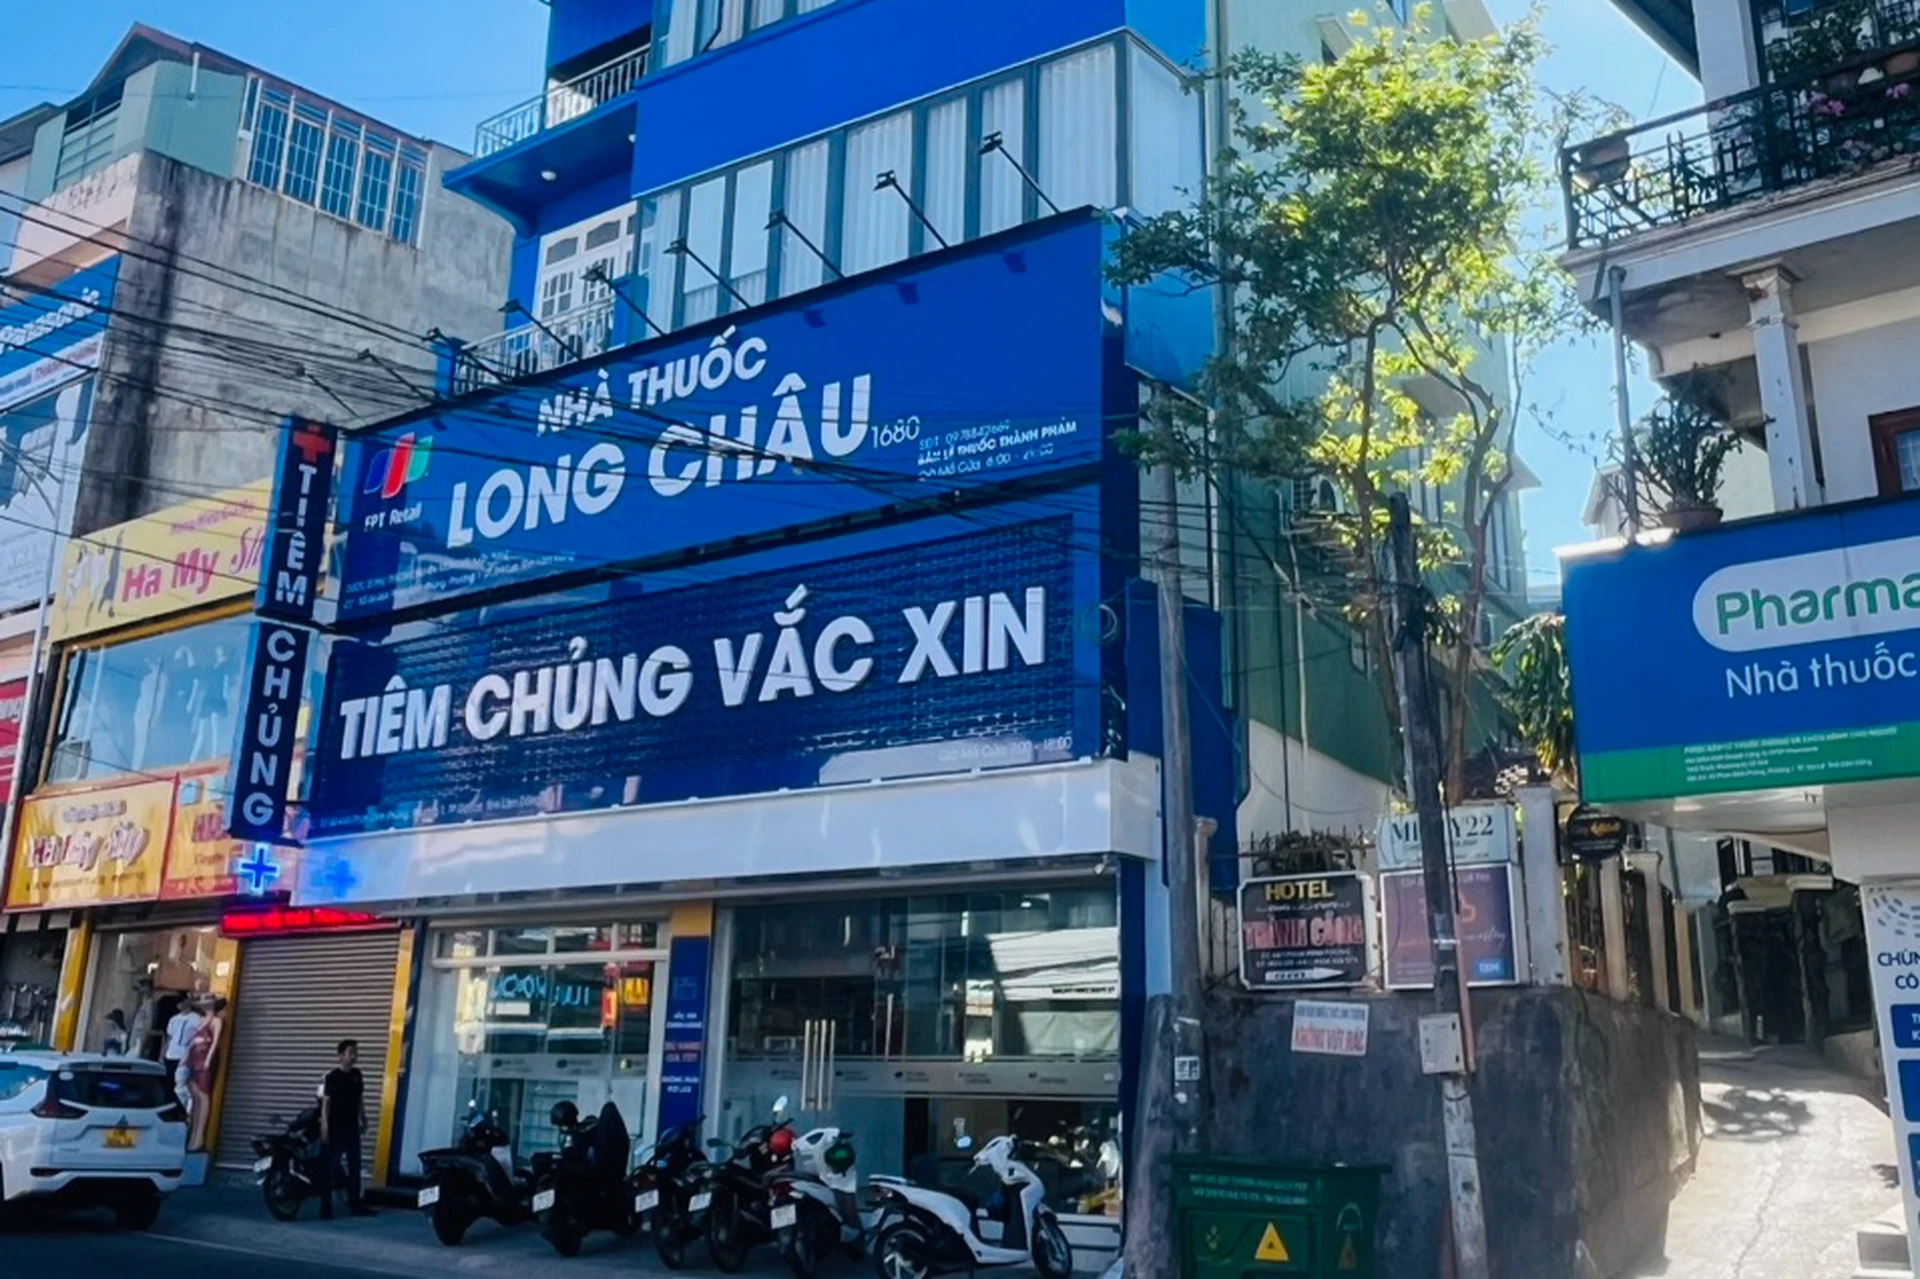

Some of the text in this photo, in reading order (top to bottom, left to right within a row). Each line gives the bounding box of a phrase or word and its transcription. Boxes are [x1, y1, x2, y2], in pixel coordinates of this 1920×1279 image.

[537, 326, 768, 437] NHÀ THUỐC
[447, 372, 920, 549] LONG CHÂU 1680
[340, 584, 1047, 760] TIÊM CHỦNG VẮC XIN
[1725, 641, 1918, 699] Nhà thuốc
[1265, 879, 1335, 901] HOTEL
